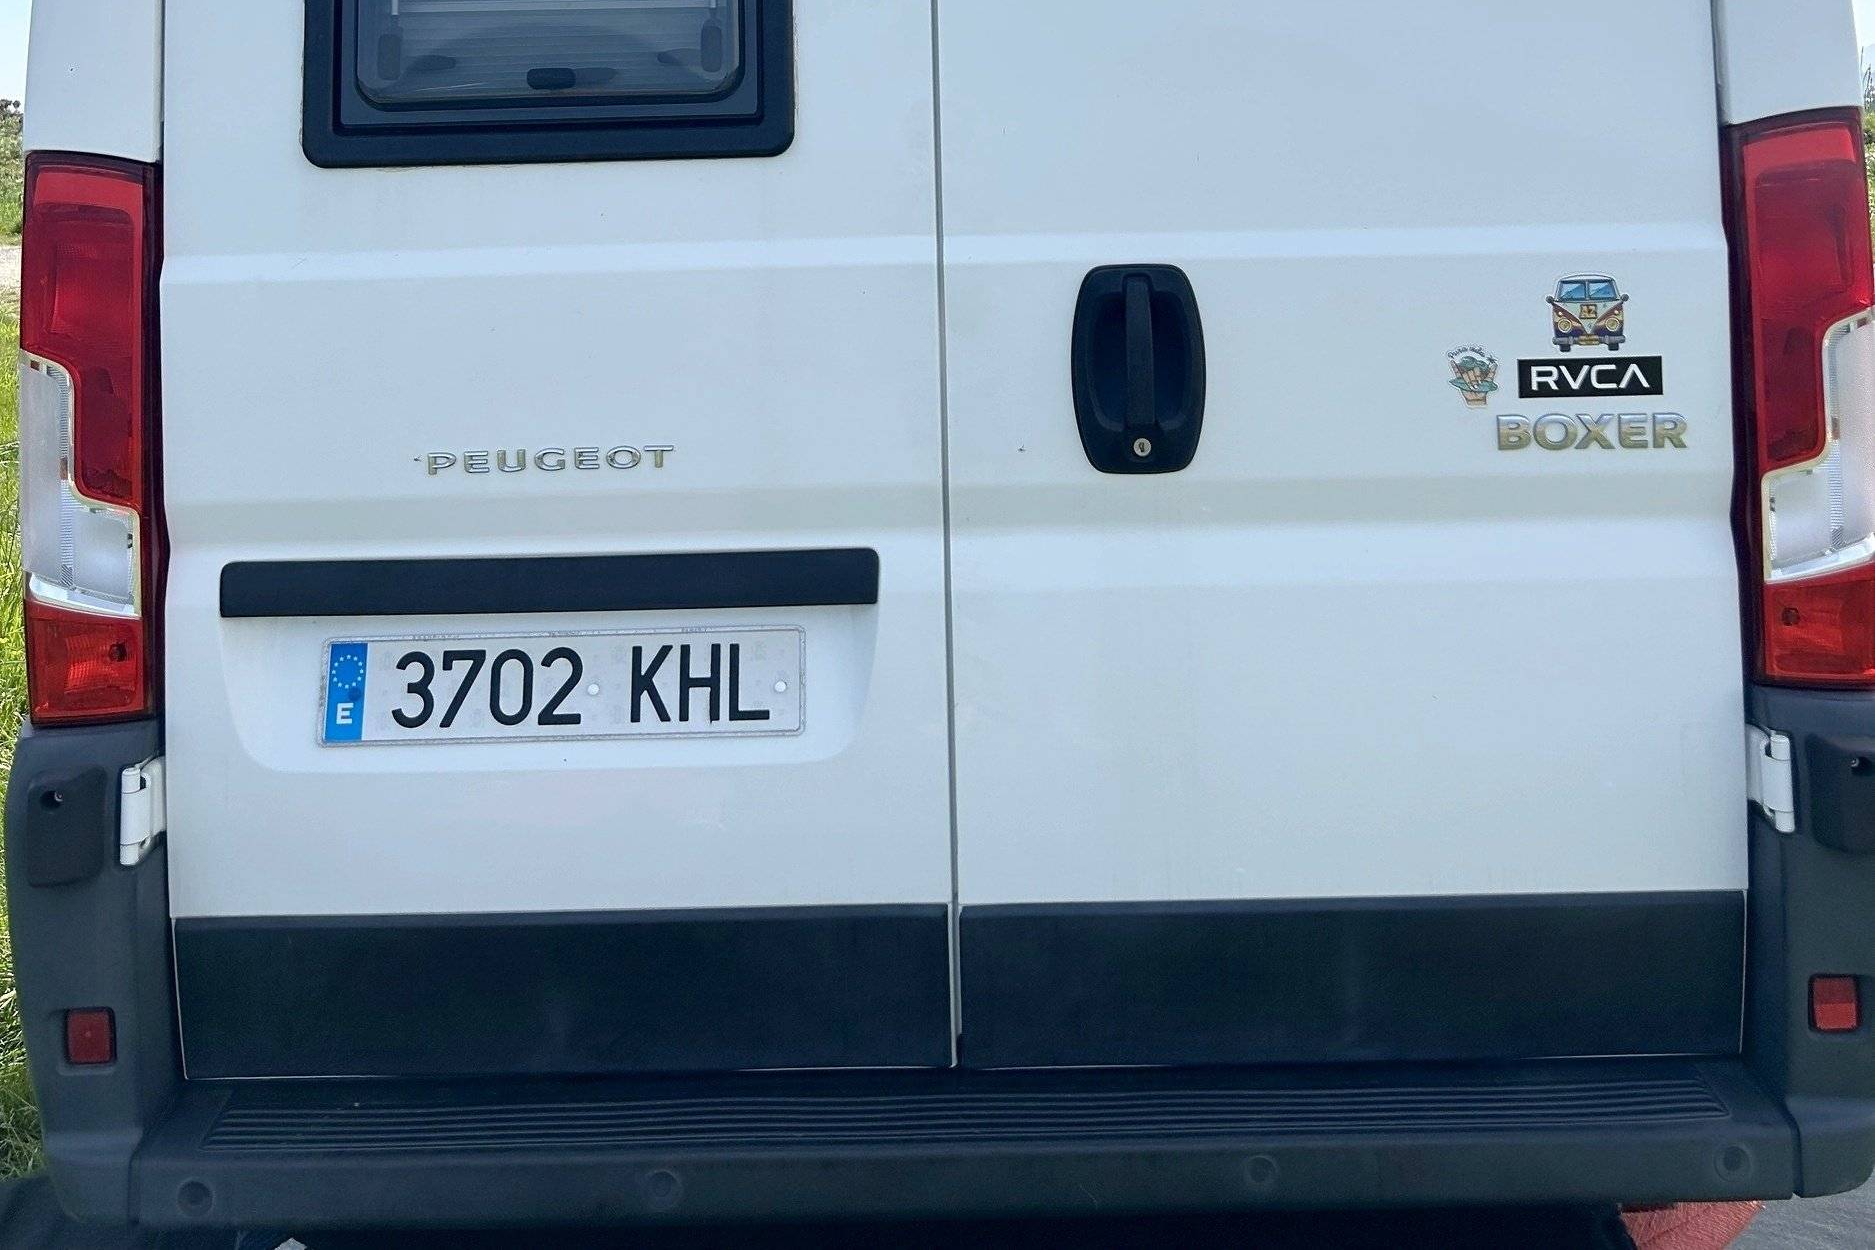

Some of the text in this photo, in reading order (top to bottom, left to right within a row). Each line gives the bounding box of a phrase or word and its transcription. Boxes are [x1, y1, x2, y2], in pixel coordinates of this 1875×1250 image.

[1530, 363, 1650, 391] RVCA
[1496, 412, 1688, 451] BOXER
[427, 444, 675, 476] PEUGEOT
[391, 643, 770, 728] 3702 KHL
[336, 702, 354, 724] E
